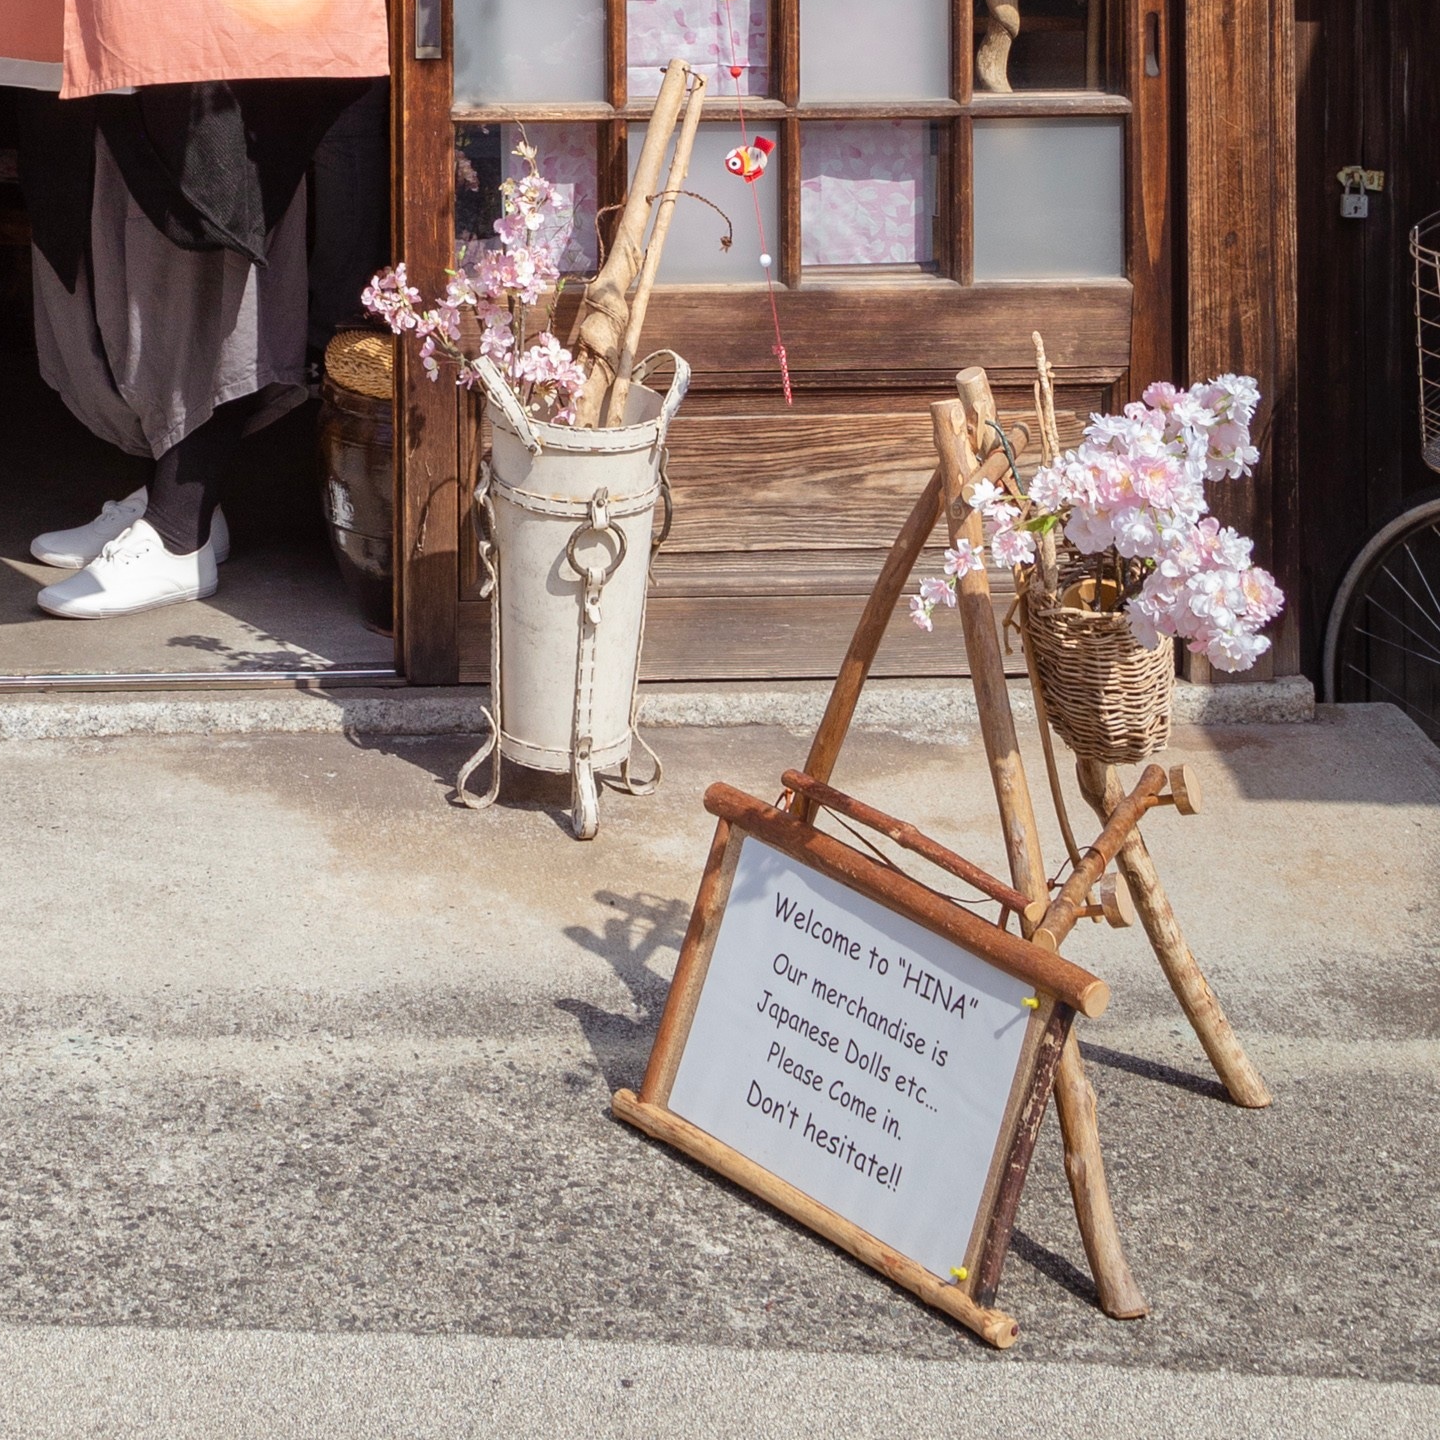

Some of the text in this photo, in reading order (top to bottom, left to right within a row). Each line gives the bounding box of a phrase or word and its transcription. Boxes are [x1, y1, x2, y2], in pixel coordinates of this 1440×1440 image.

[772, 953, 949, 1068] Our merchandise is
[774, 892, 979, 1020] Welcome to "HINA"
[756, 989, 938, 1113] Japanese Dolls etc...
[766, 1041, 903, 1142] Please Come in.
[746, 1079, 904, 1193] Don't hesitate!!
